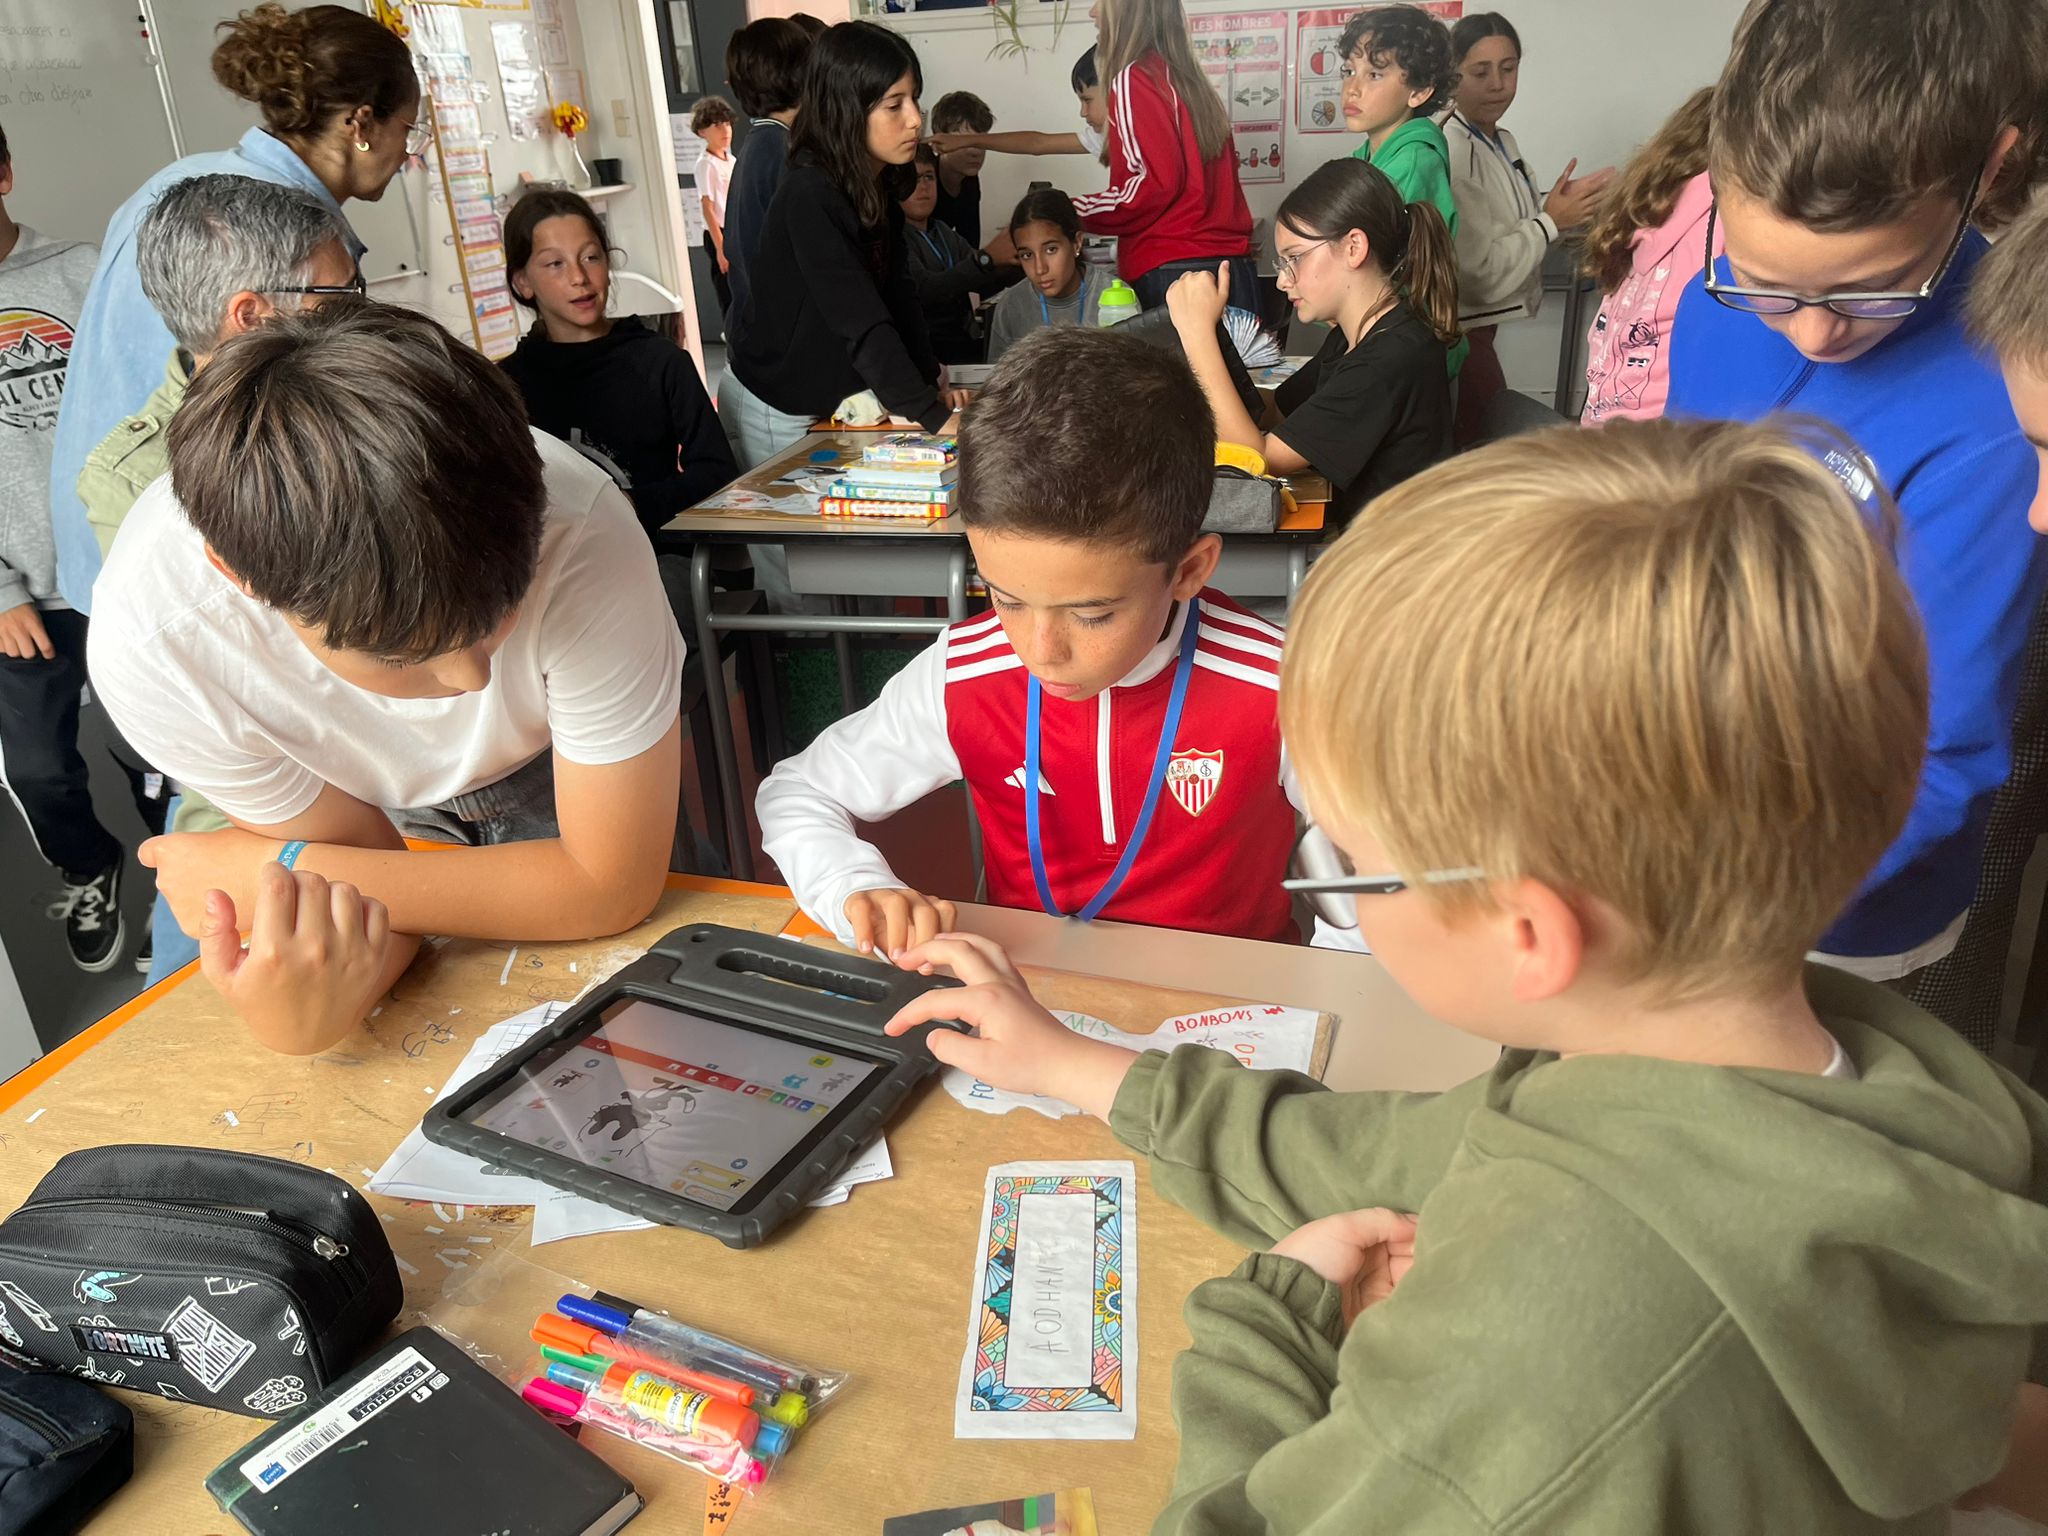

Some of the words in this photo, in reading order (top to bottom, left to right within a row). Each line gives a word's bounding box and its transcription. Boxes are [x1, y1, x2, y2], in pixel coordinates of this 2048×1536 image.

[1193, 20, 1214, 32] LES
[1216, 16, 1272, 31] NOMBRES
[1174, 1010, 1253, 1034] BONBONS
[1030, 1264, 1070, 1354] AODHAN
[80, 1326, 171, 1360] FORTNITE
[358, 1367, 424, 1418] BOUCHUT
